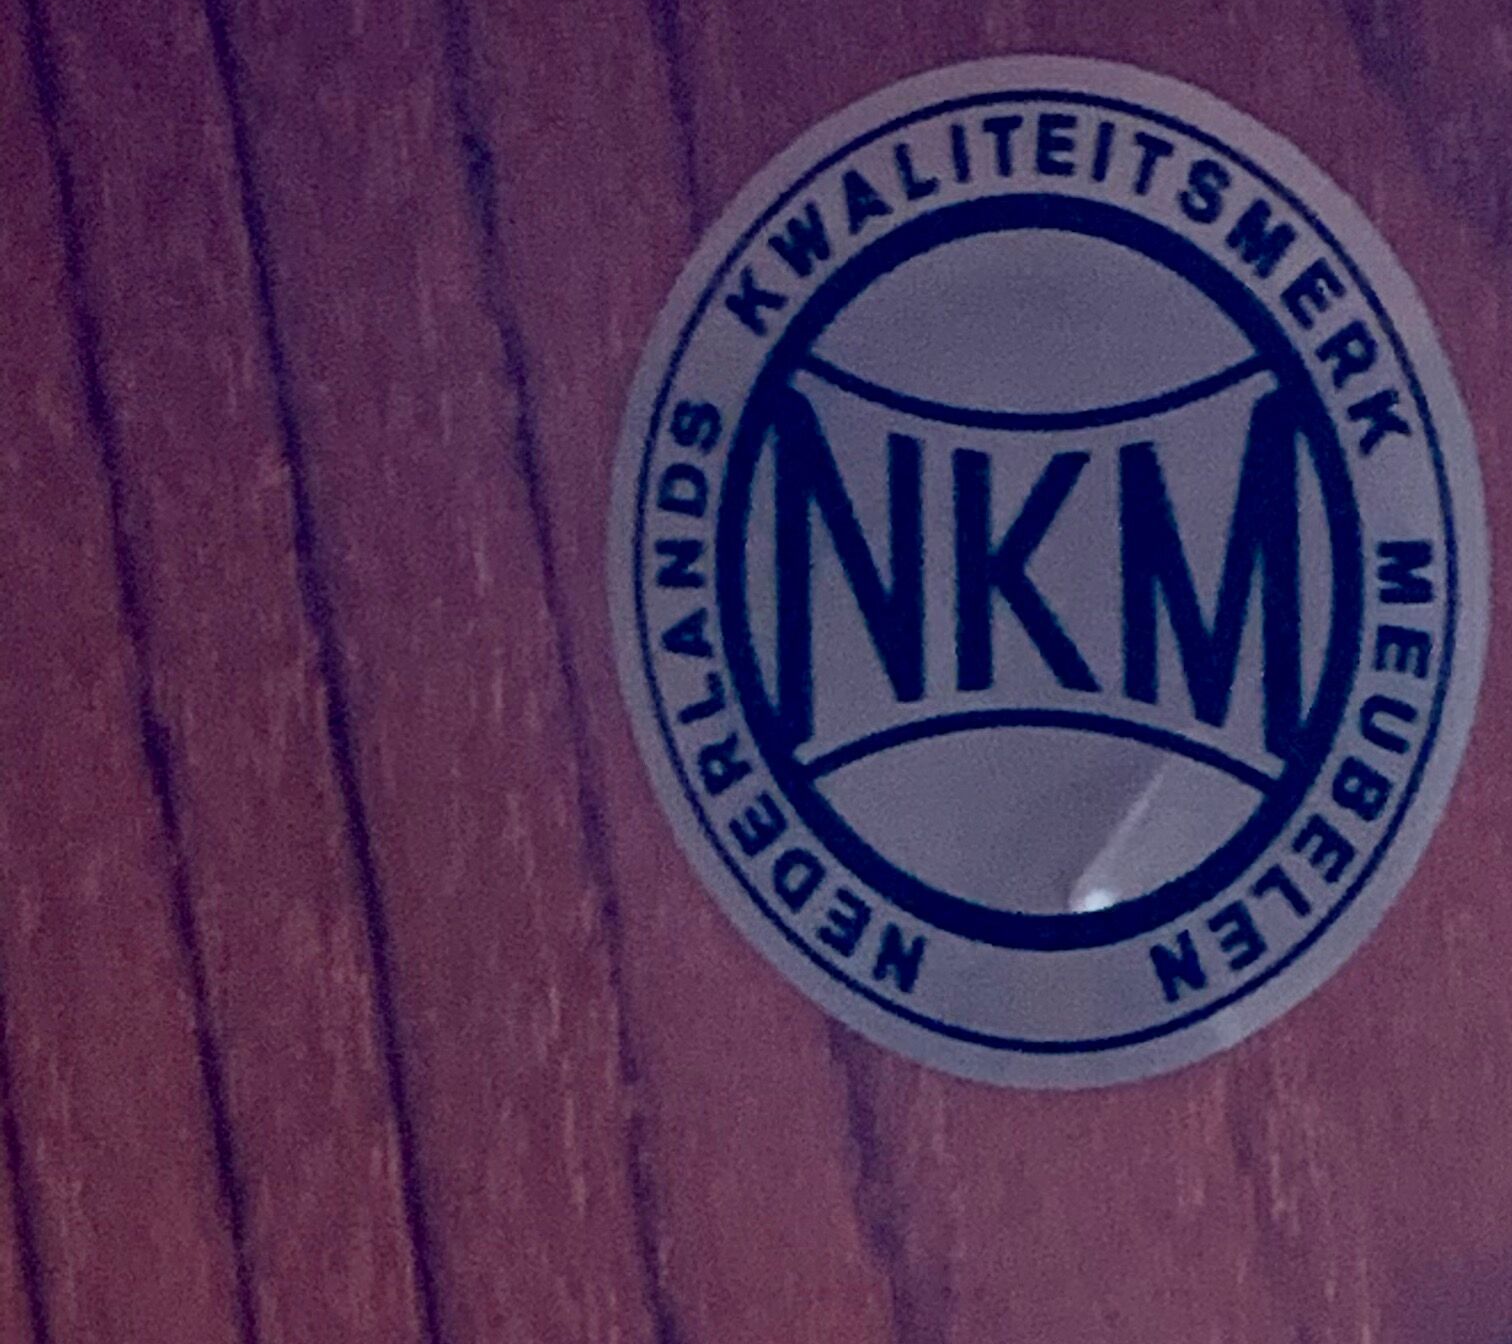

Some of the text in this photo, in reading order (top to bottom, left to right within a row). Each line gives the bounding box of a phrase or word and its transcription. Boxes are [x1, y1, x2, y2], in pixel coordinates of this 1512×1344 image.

[654, 111, 1434, 1002] NEDERLANDS KWALITEITSMERK MEUBELEN
[774, 378, 1306, 760] NKM
